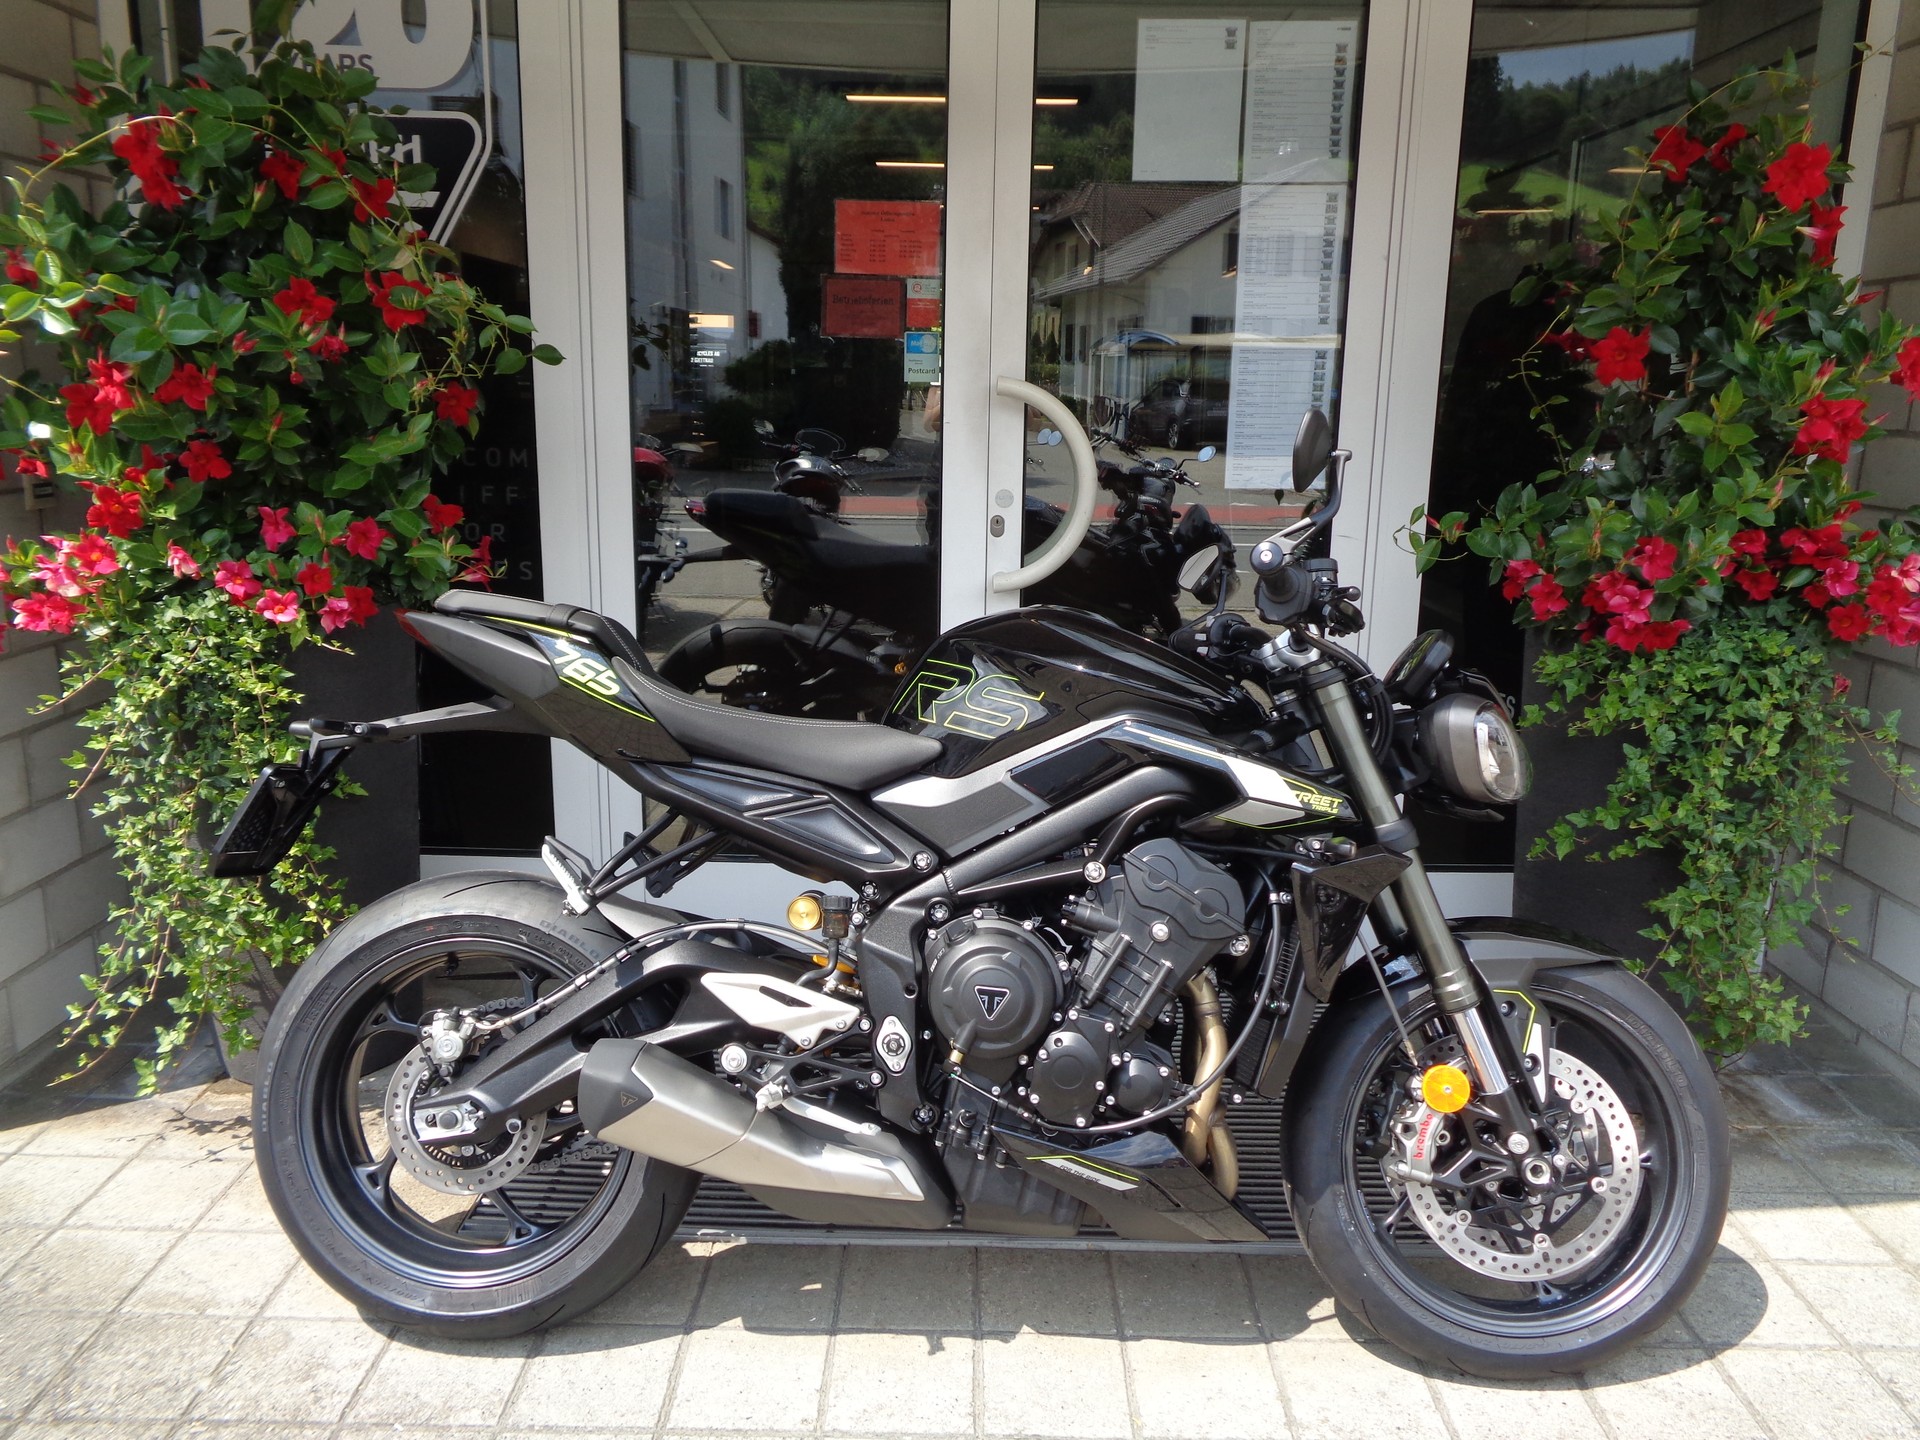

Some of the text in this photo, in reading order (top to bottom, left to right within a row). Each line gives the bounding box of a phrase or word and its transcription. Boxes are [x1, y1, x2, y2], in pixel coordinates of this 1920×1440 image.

[554, 637, 620, 696] 765
[892, 658, 1046, 740] RS
[1290, 789, 1343, 809] TREET
[1311, 804, 1339, 814] TRIPLE
[539, 920, 601, 961] DIABLO
[261, 1061, 275, 1133] DIABLO
[1412, 1113, 1434, 1159] brembo
[1060, 1164, 1073, 1174] FOR
[1073, 1168, 1085, 1178] THE
